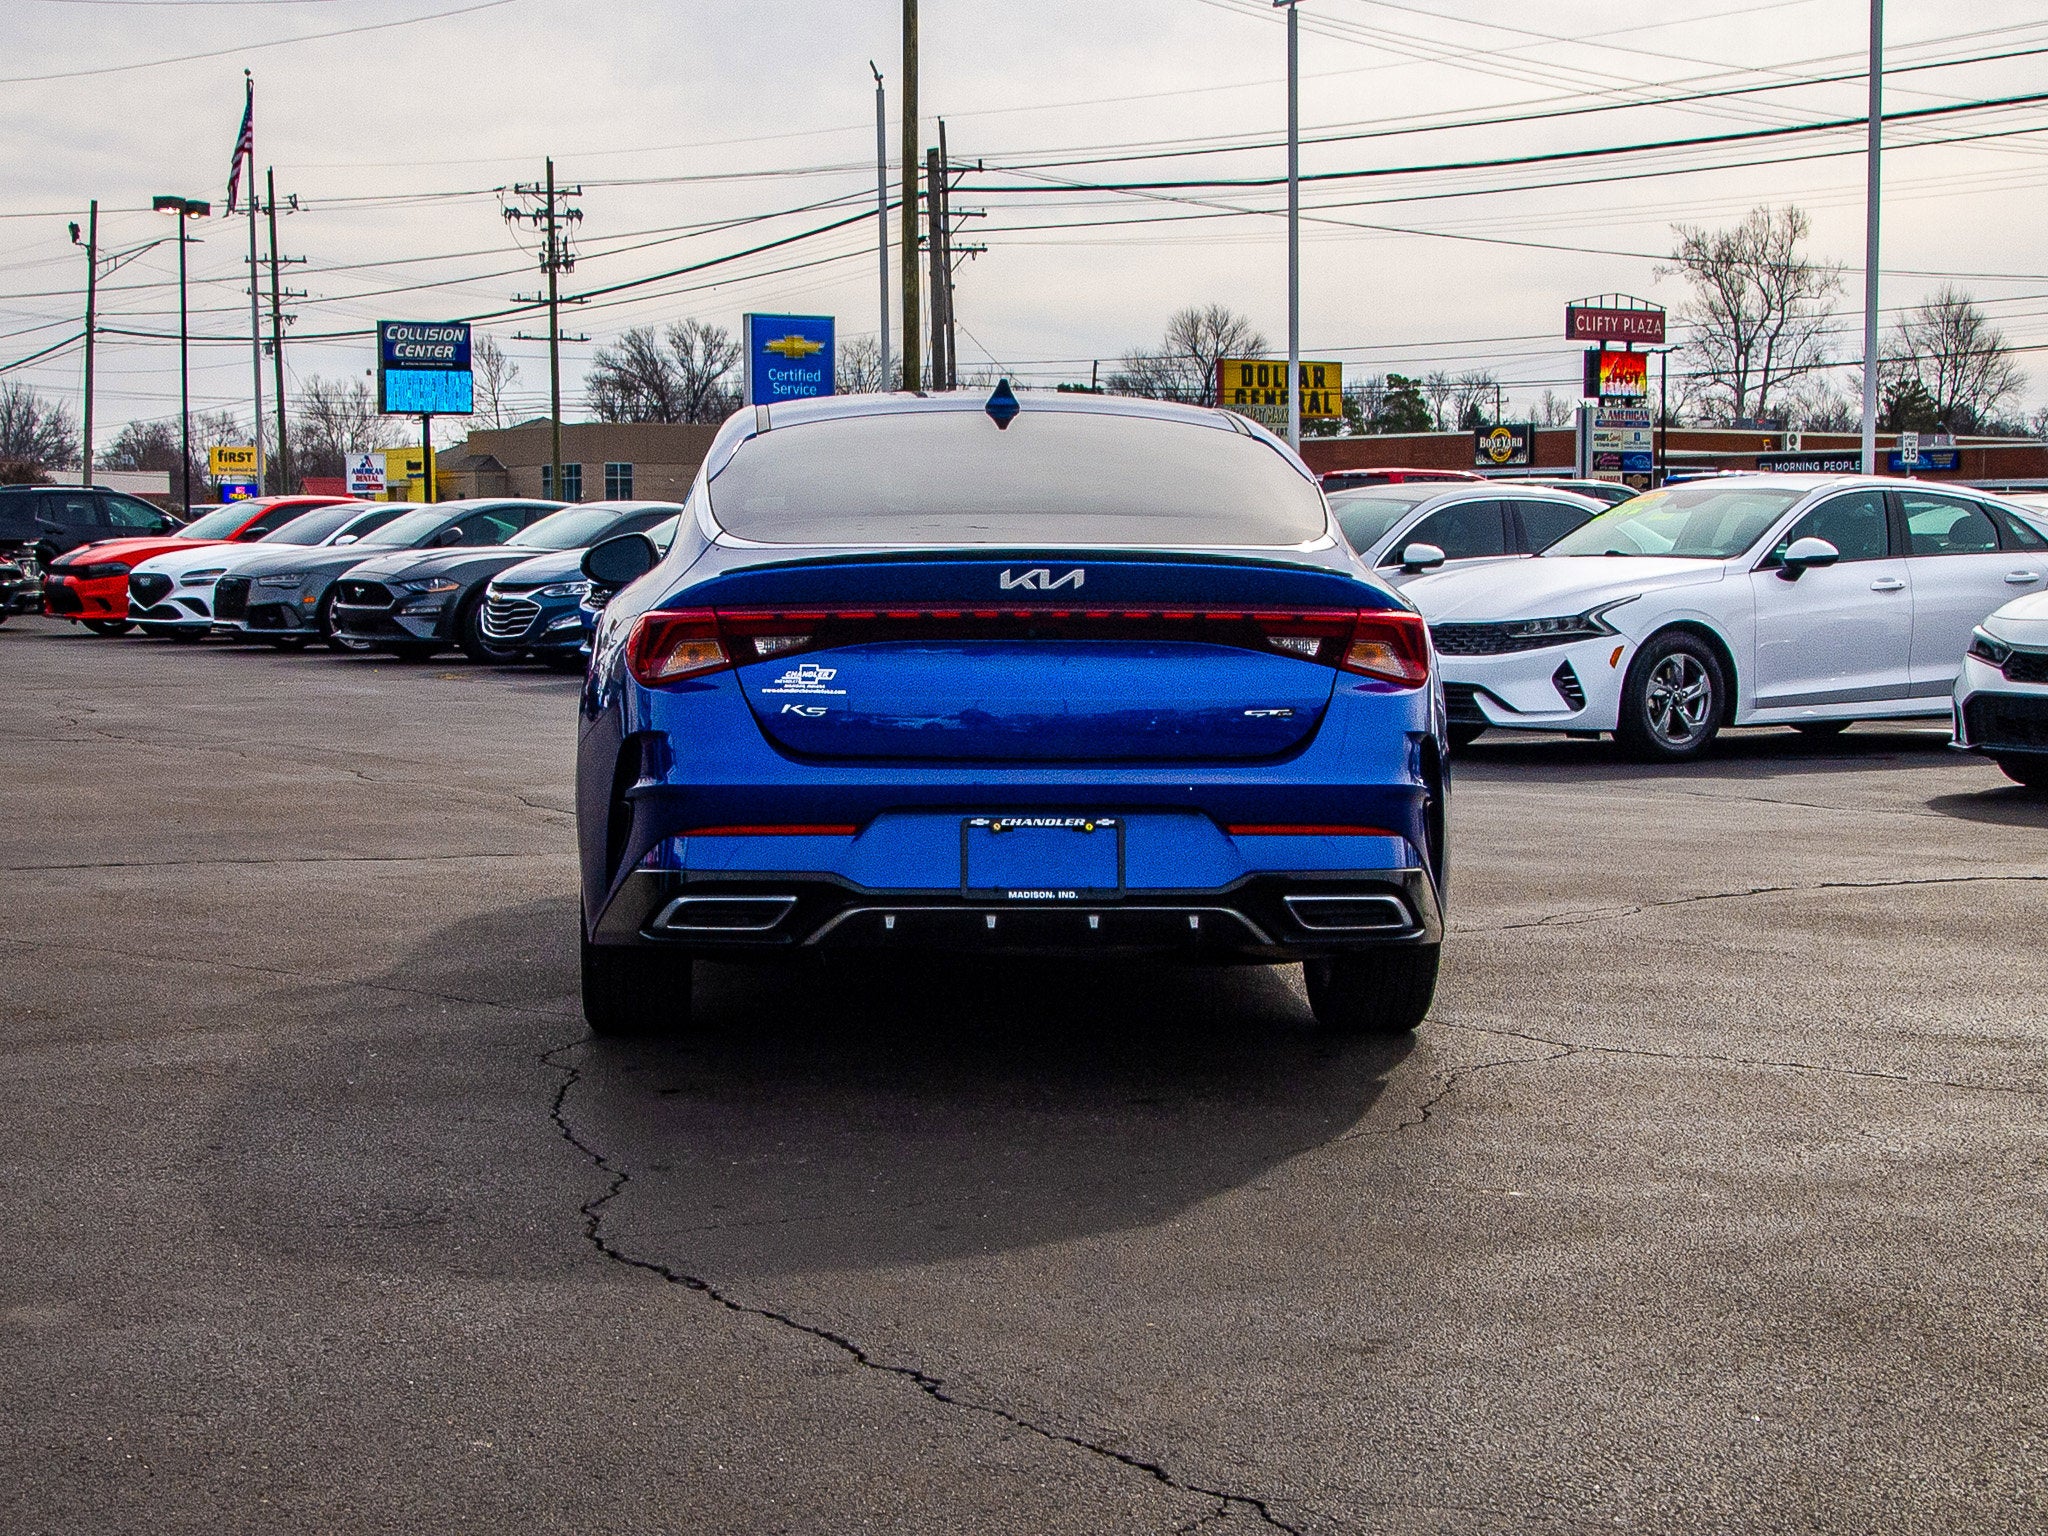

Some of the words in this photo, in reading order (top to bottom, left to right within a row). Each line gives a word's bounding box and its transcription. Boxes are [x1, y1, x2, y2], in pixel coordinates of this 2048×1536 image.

[1576, 315, 1618, 332] CLIFTY
[1623, 317, 1662, 335] PLAZA
[386, 325, 465, 341] COLLISION
[395, 343, 454, 358] CENTER
[768, 368, 821, 382] Certified
[772, 382, 817, 395] Service
[1608, 409, 1649, 420] AMERICAN
[1903, 447, 1917, 460] 35
[1775, 462, 1820, 472] MORNING
[1823, 460, 1861, 471] PEOPLE
[781, 704, 829, 717] K5
[1000, 818, 1086, 826] CHANDLER
[1058, 891, 1079, 899] IND.
